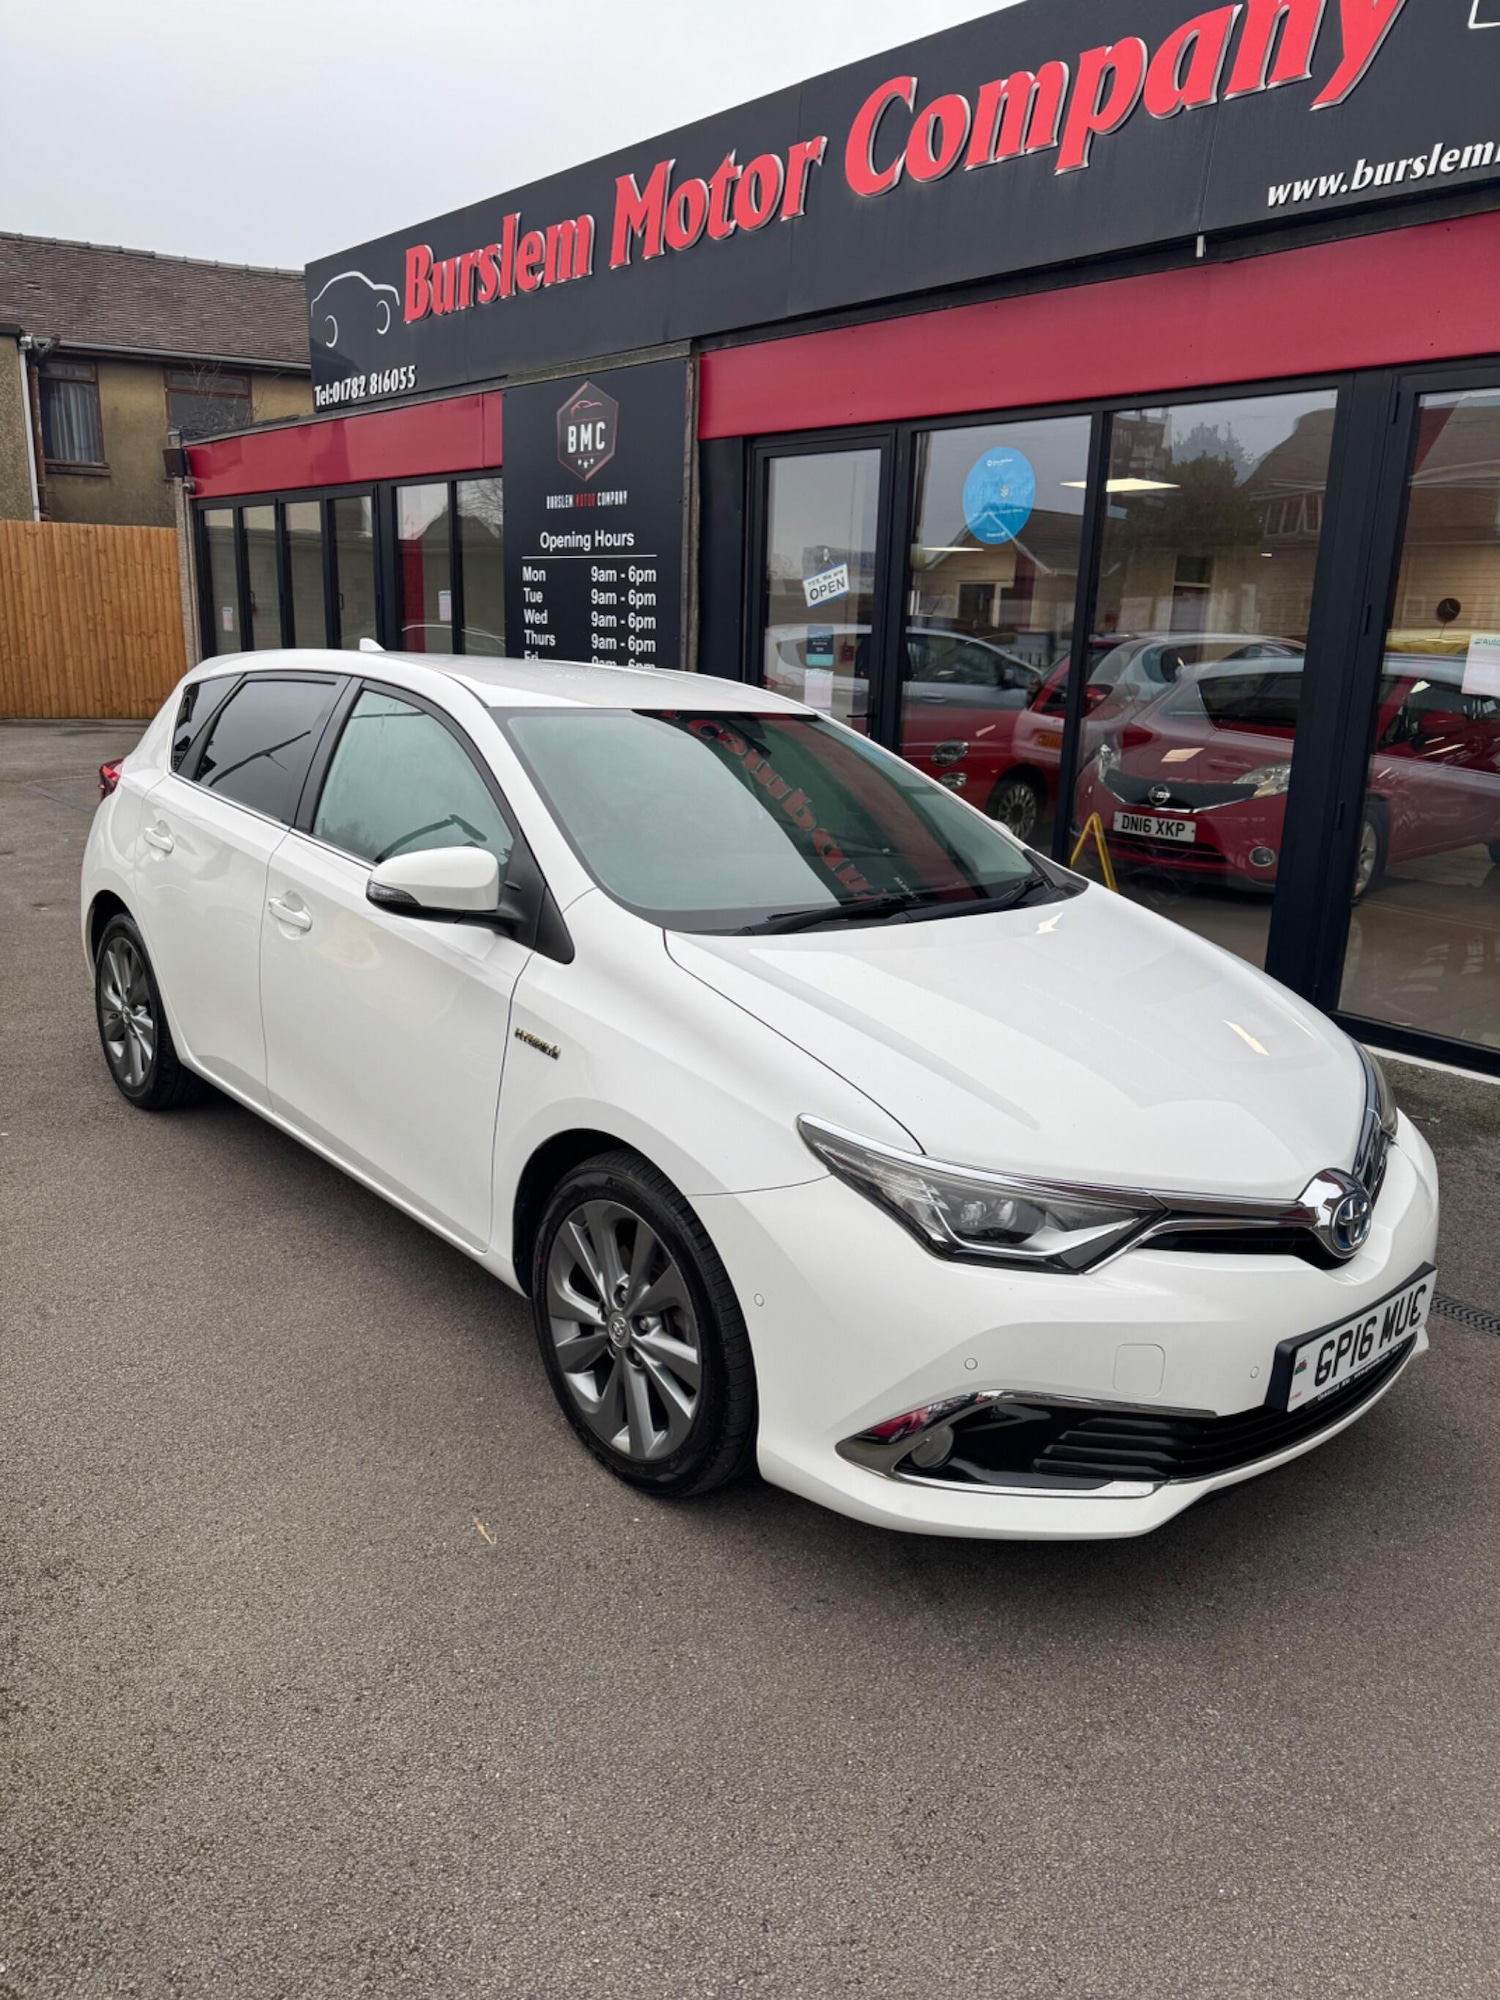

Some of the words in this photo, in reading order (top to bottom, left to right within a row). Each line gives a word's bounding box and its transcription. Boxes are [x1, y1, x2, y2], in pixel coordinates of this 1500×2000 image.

[402, 212, 596, 323] Burslem
[608, 136, 828, 270] Motor
[845, 0, 1404, 197] Company
[1268, 141, 1500, 206] www.burslem
[370, 365, 416, 395] 816055
[568, 421, 606, 453] BMC
[540, 531, 591, 552] Opening
[594, 529, 635, 547] Hours
[522, 566, 546, 581] Mon
[591, 566, 617, 582] 9am
[628, 566, 656, 586] 6pm
[810, 576, 846, 600] OPEN
[523, 587, 543, 603] Tue
[591, 588, 617, 605] 9am
[628, 589, 656, 609] 6pm
[523, 609, 548, 624] Wed
[591, 611, 617, 627] 9am
[628, 612, 656, 632] 6pm
[523, 629, 556, 646] Thurs
[591, 633, 617, 650] 9am
[628, 635, 656, 655] 6pm
[1121, 815, 1152, 834] DN16
[1155, 820, 1186, 838] XKP
[1314, 1315, 1378, 1387] GP16
[1378, 1283, 1427, 1349] MUE
